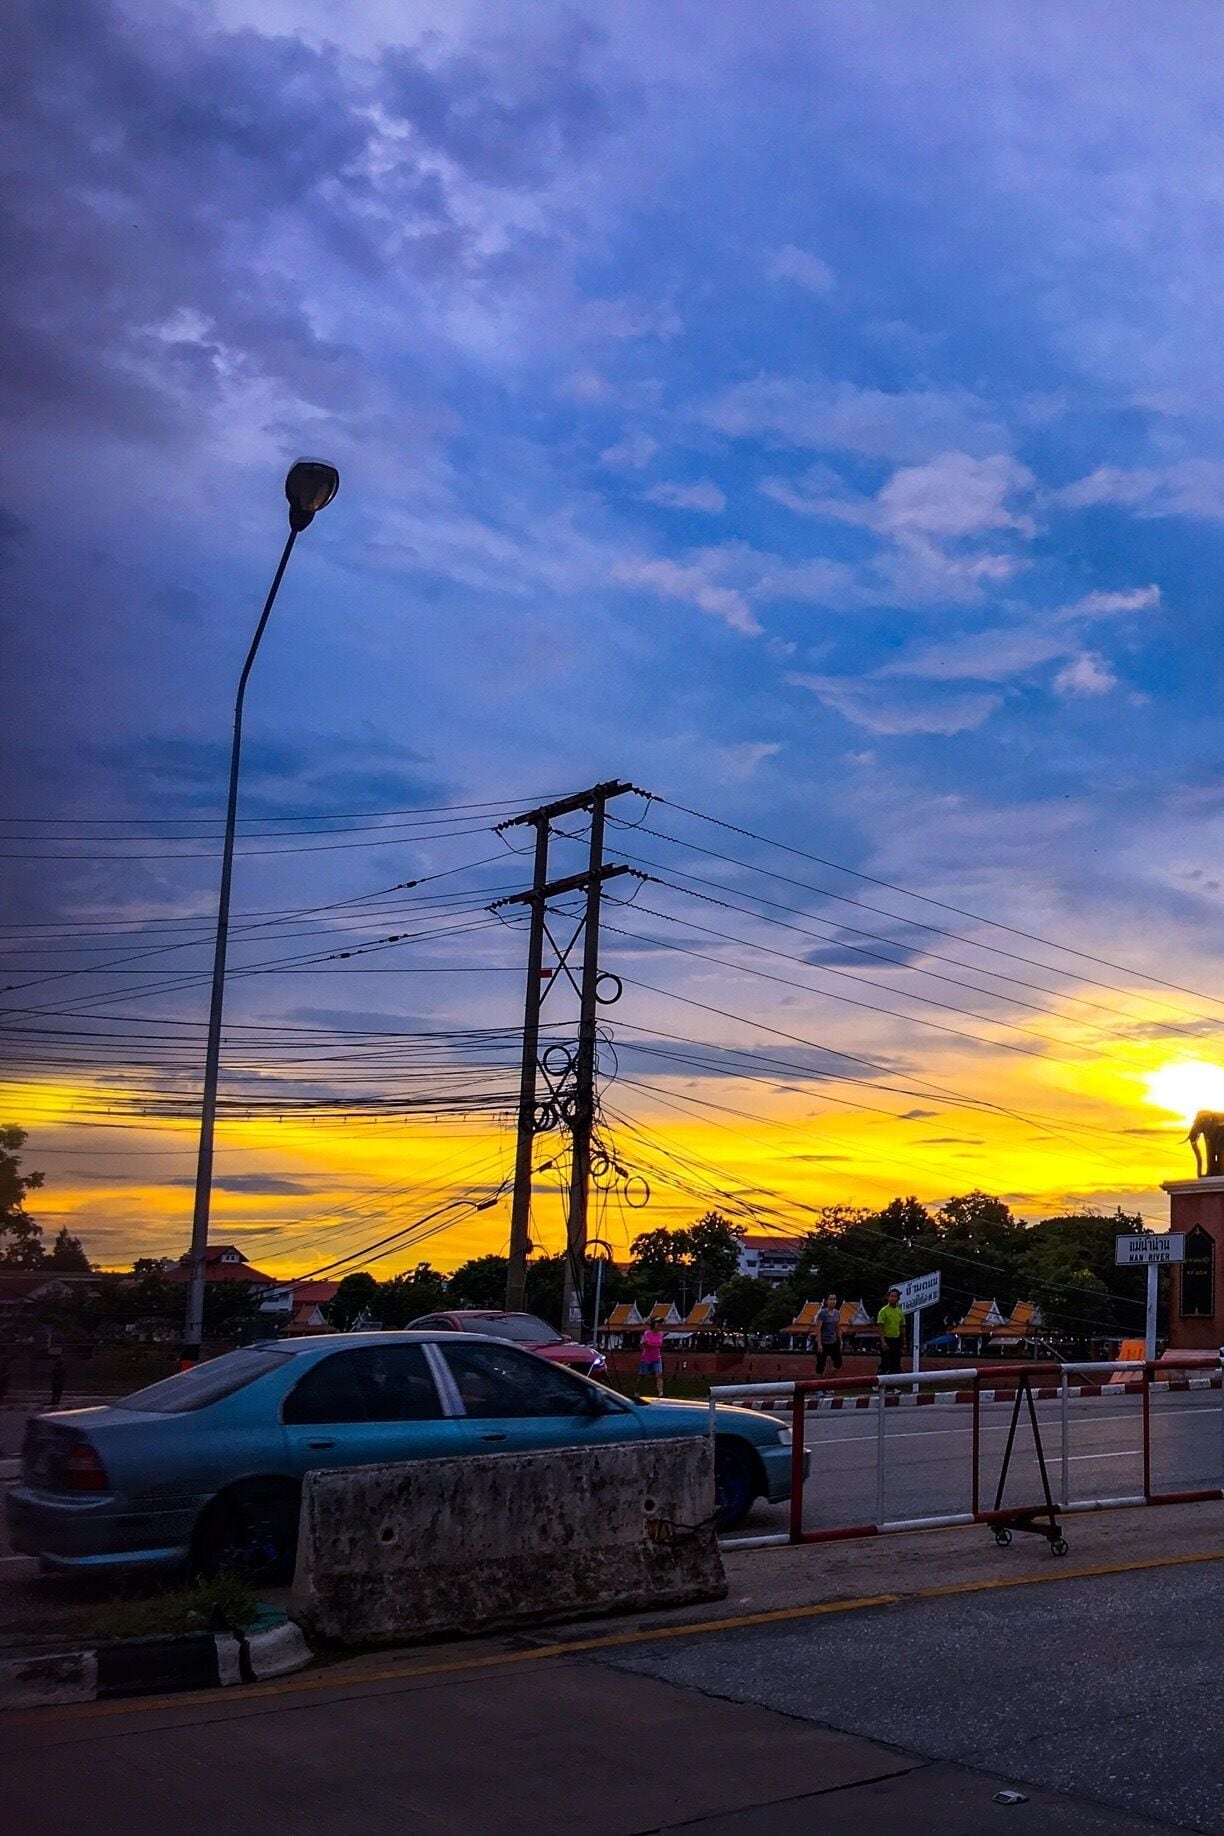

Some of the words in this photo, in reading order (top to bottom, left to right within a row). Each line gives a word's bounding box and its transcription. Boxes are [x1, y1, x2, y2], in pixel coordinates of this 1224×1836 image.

[1129, 1237, 1170, 1252] แม่น้ำน่าน
[1129, 1253, 1144, 1261] NAN
[1148, 1253, 1170, 1261] RIVER
